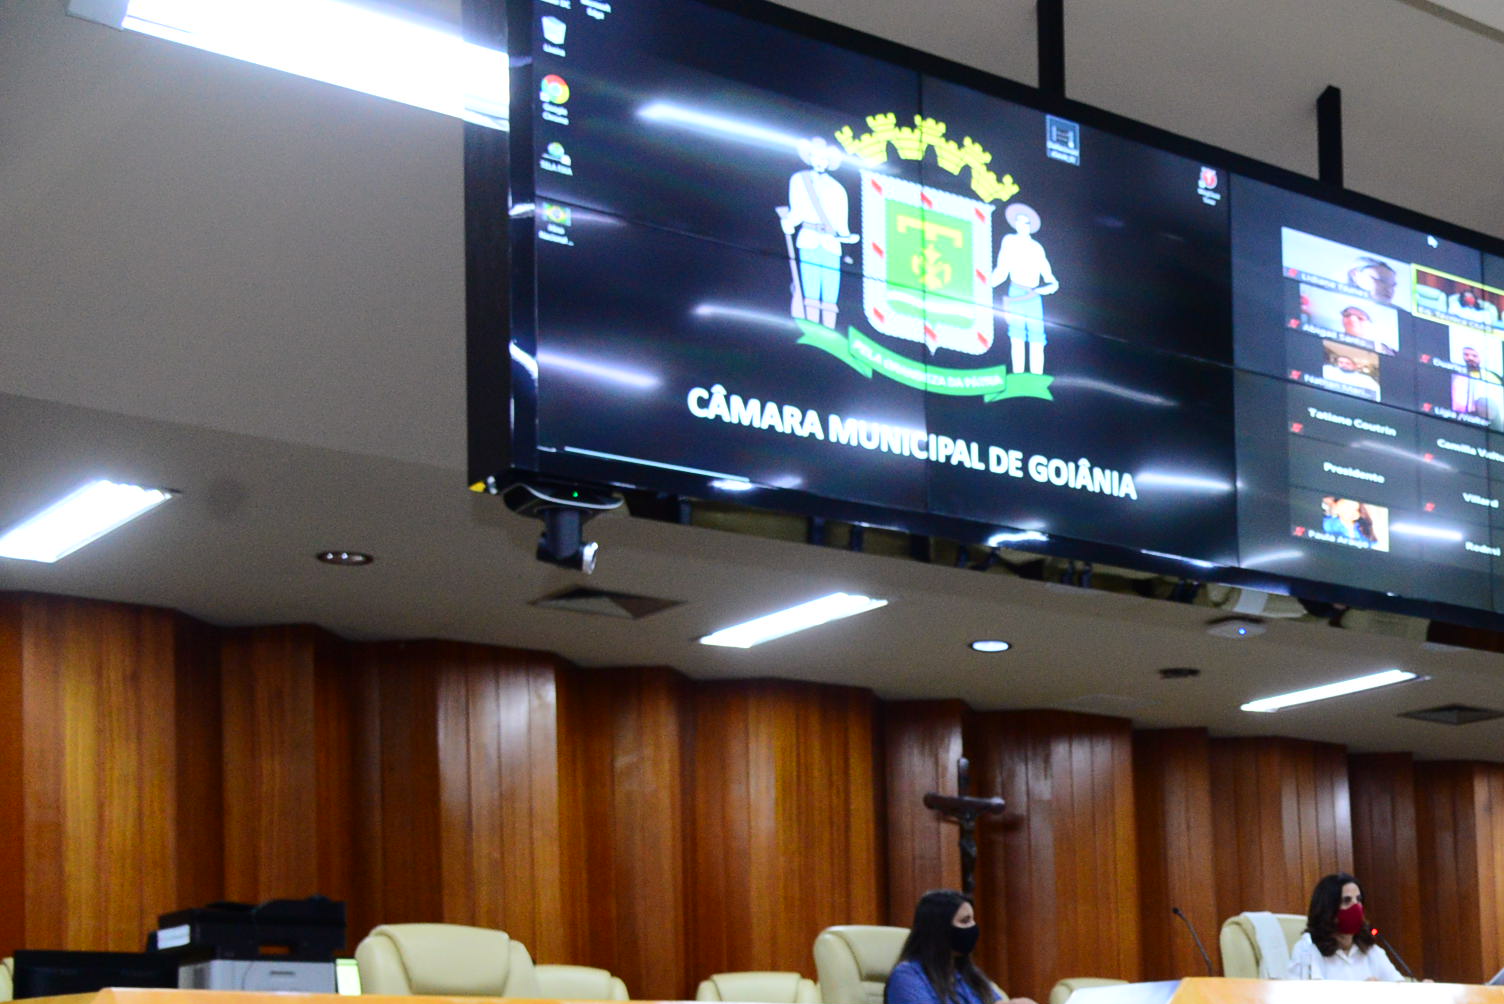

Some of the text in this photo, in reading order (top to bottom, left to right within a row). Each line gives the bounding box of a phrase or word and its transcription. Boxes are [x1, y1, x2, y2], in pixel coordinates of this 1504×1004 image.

[687, 383, 1138, 500] CÂMARA MUNICIPAL DE GOIÂNIA
